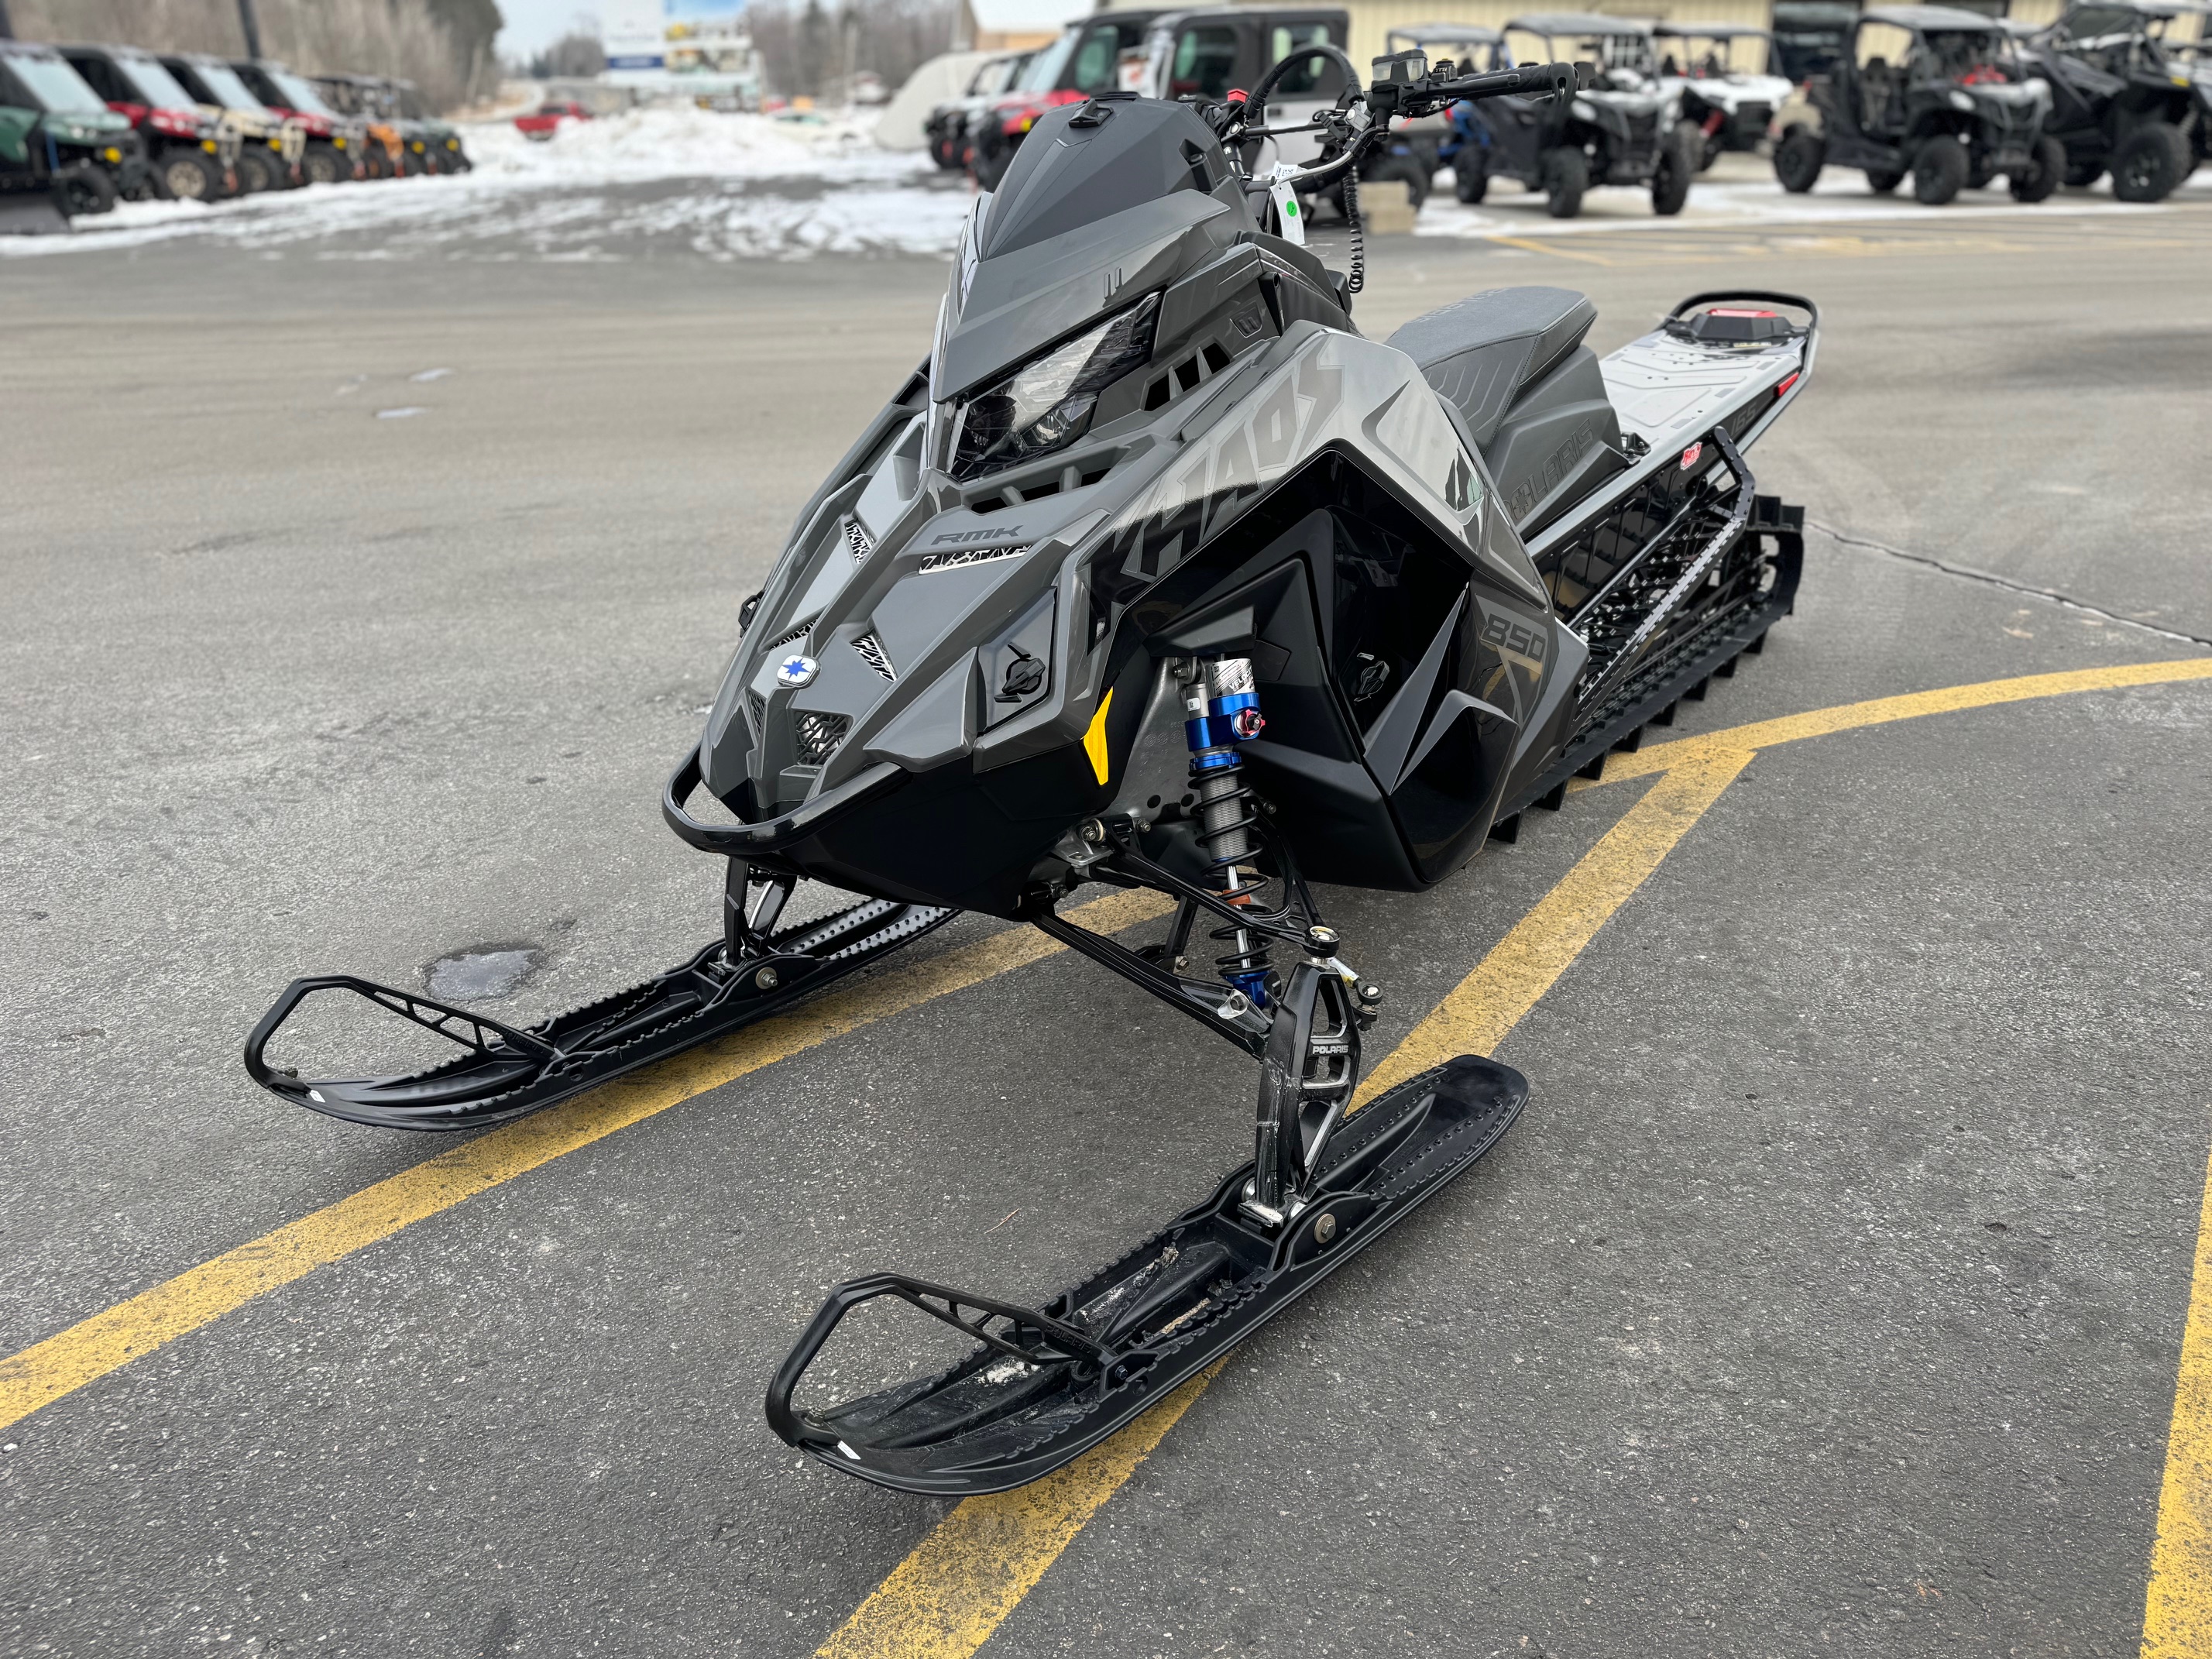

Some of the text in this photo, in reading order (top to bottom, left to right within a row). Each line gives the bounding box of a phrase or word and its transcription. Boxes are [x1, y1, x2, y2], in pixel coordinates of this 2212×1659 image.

[1731, 401, 1757, 437] 165
[930, 525, 1023, 545] RMK
[1481, 613, 1546, 663] 850
[1313, 1045, 1348, 1054] POLARIS
